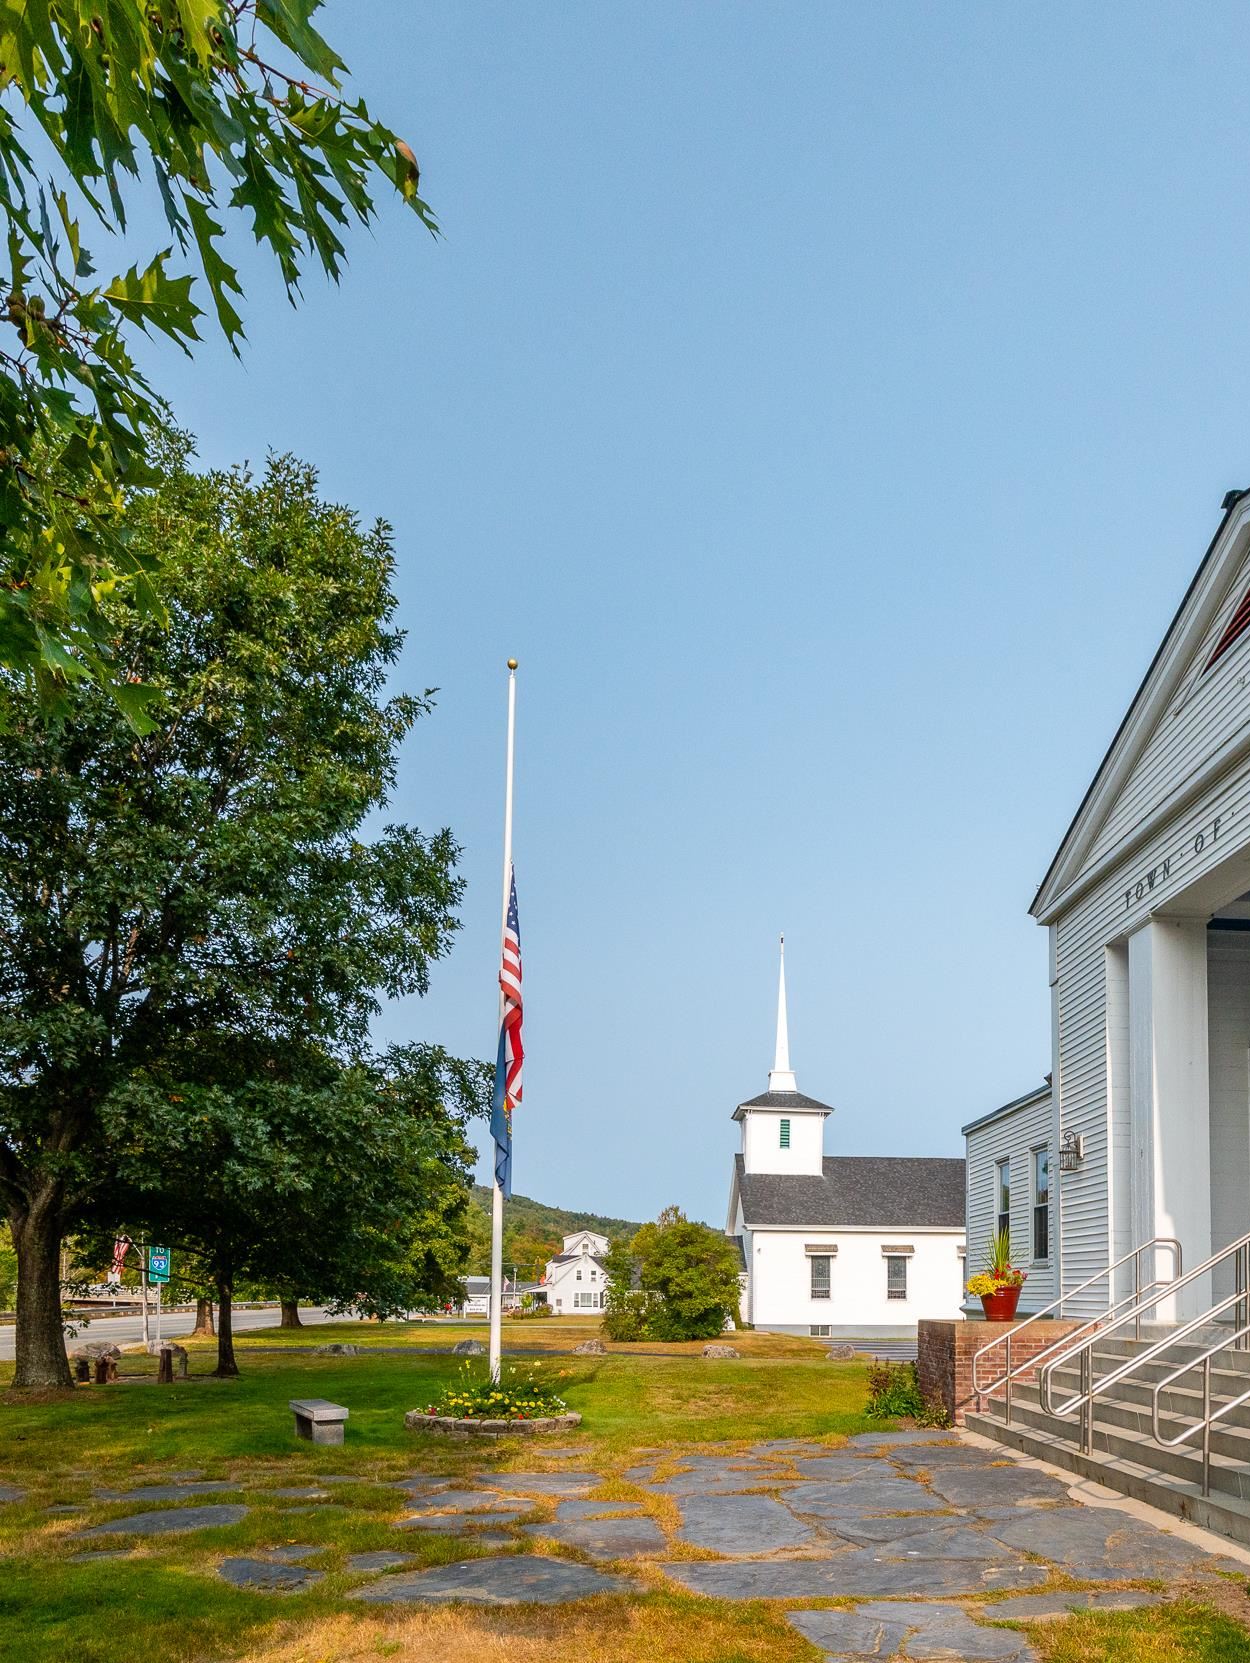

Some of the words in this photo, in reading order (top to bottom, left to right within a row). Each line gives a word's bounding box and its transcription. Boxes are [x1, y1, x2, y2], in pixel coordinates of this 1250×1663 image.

[1125, 858, 1170, 909] TOWN
[1194, 818, 1221, 855] OF
[154, 1260, 164, 1269] 93
